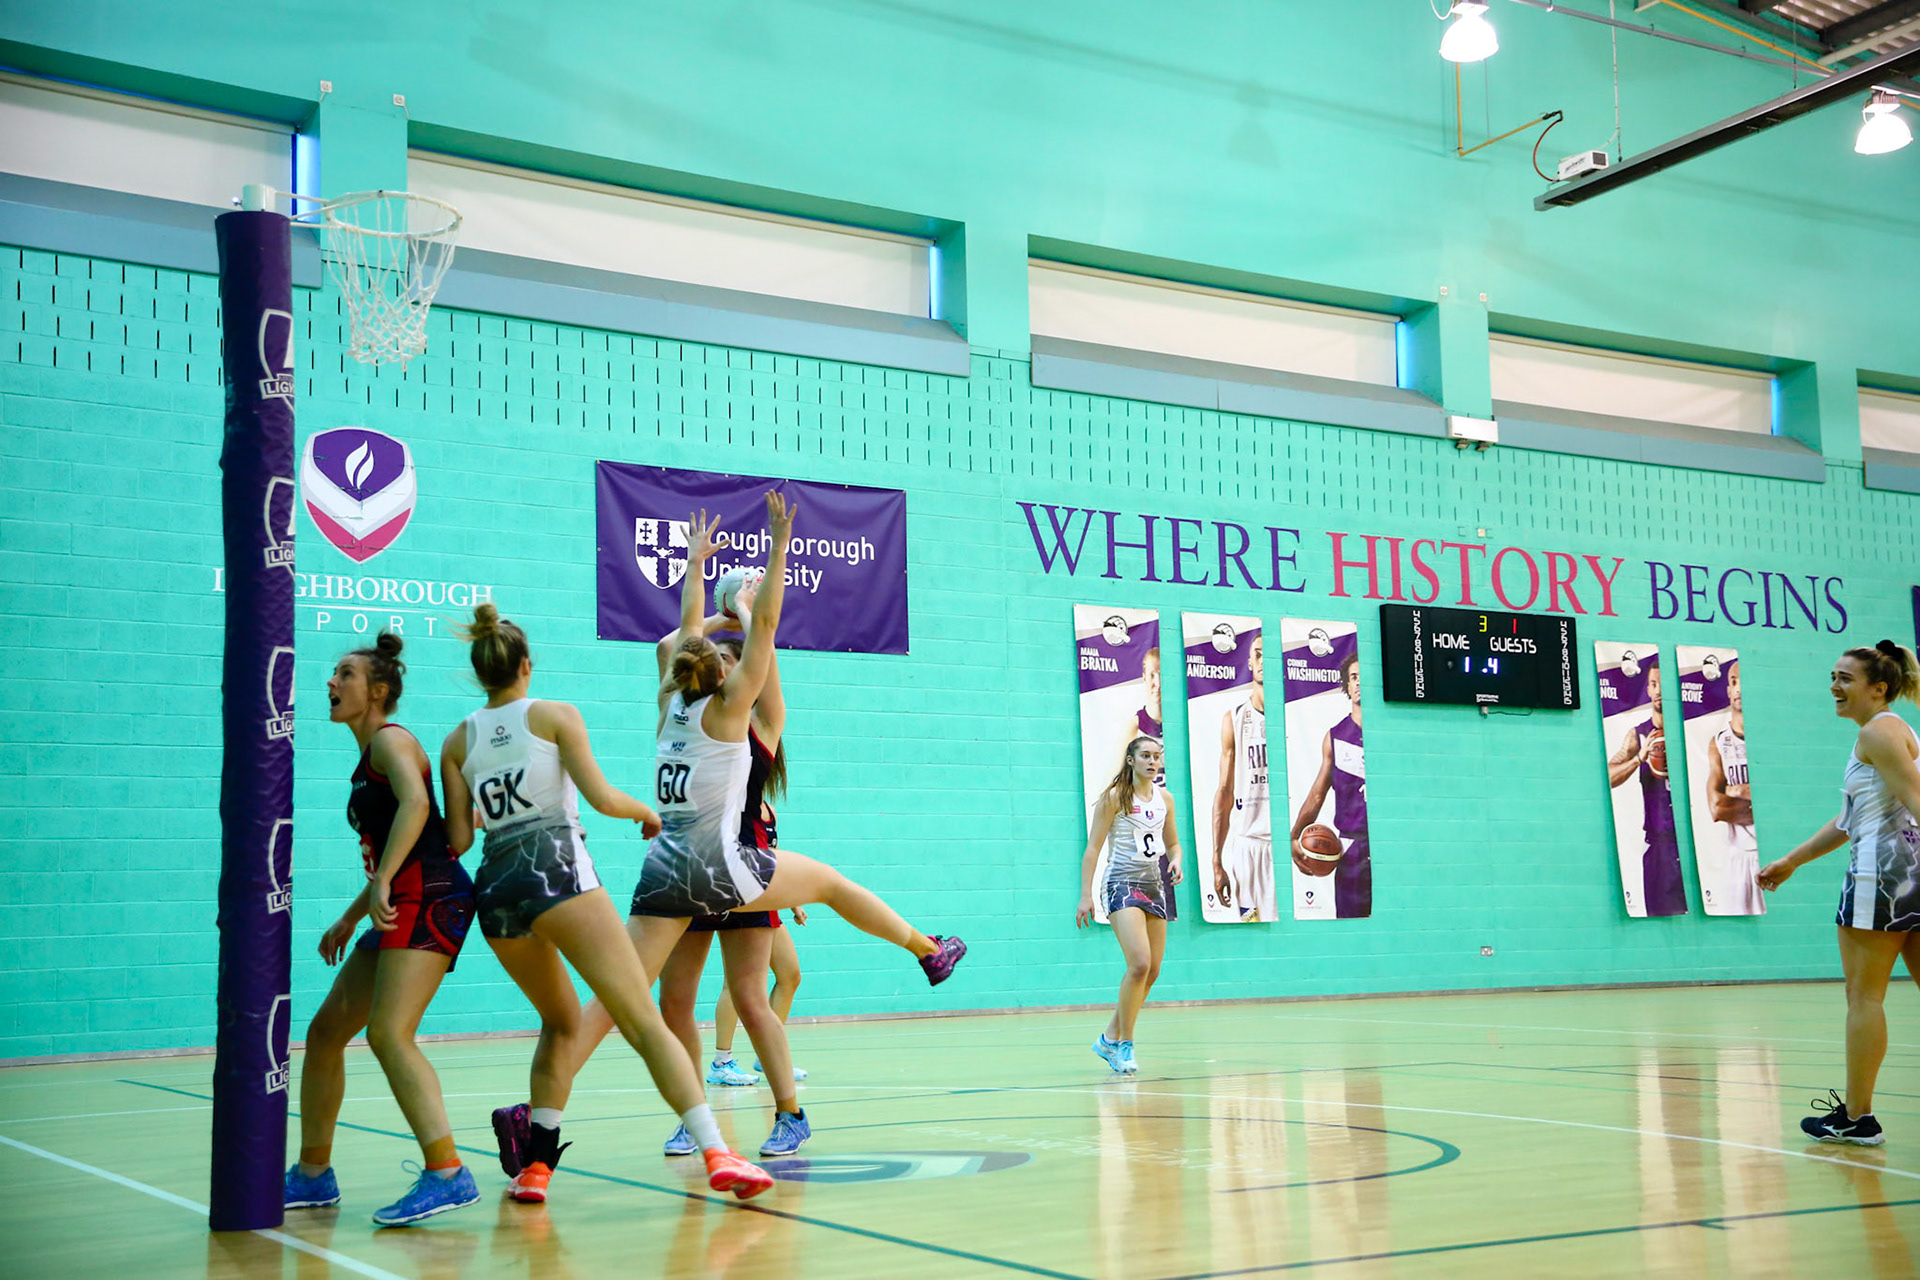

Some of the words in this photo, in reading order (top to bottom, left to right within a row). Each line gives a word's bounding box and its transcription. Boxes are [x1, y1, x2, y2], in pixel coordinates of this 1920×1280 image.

[1015, 501, 1306, 593] WHERE
[1325, 531, 1625, 617] HISTORY
[1644, 561, 1848, 634] BEGINS
[212, 568, 493, 606] LGHBOROUGH
[1479, 615, 1488, 632] 3
[1512, 618, 1517, 634] 1
[1432, 633, 1470, 650] HOME
[1490, 636, 1537, 654] GUESTS
[1081, 656, 1118, 672] BRATKA
[1187, 663, 1236, 680] ANDERSON
[1464, 656, 1470, 672] 1
[1600, 686, 1619, 700] NOEL
[658, 763, 691, 804] GD
[479, 768, 533, 820] GK
[1143, 833, 1156, 858] C
